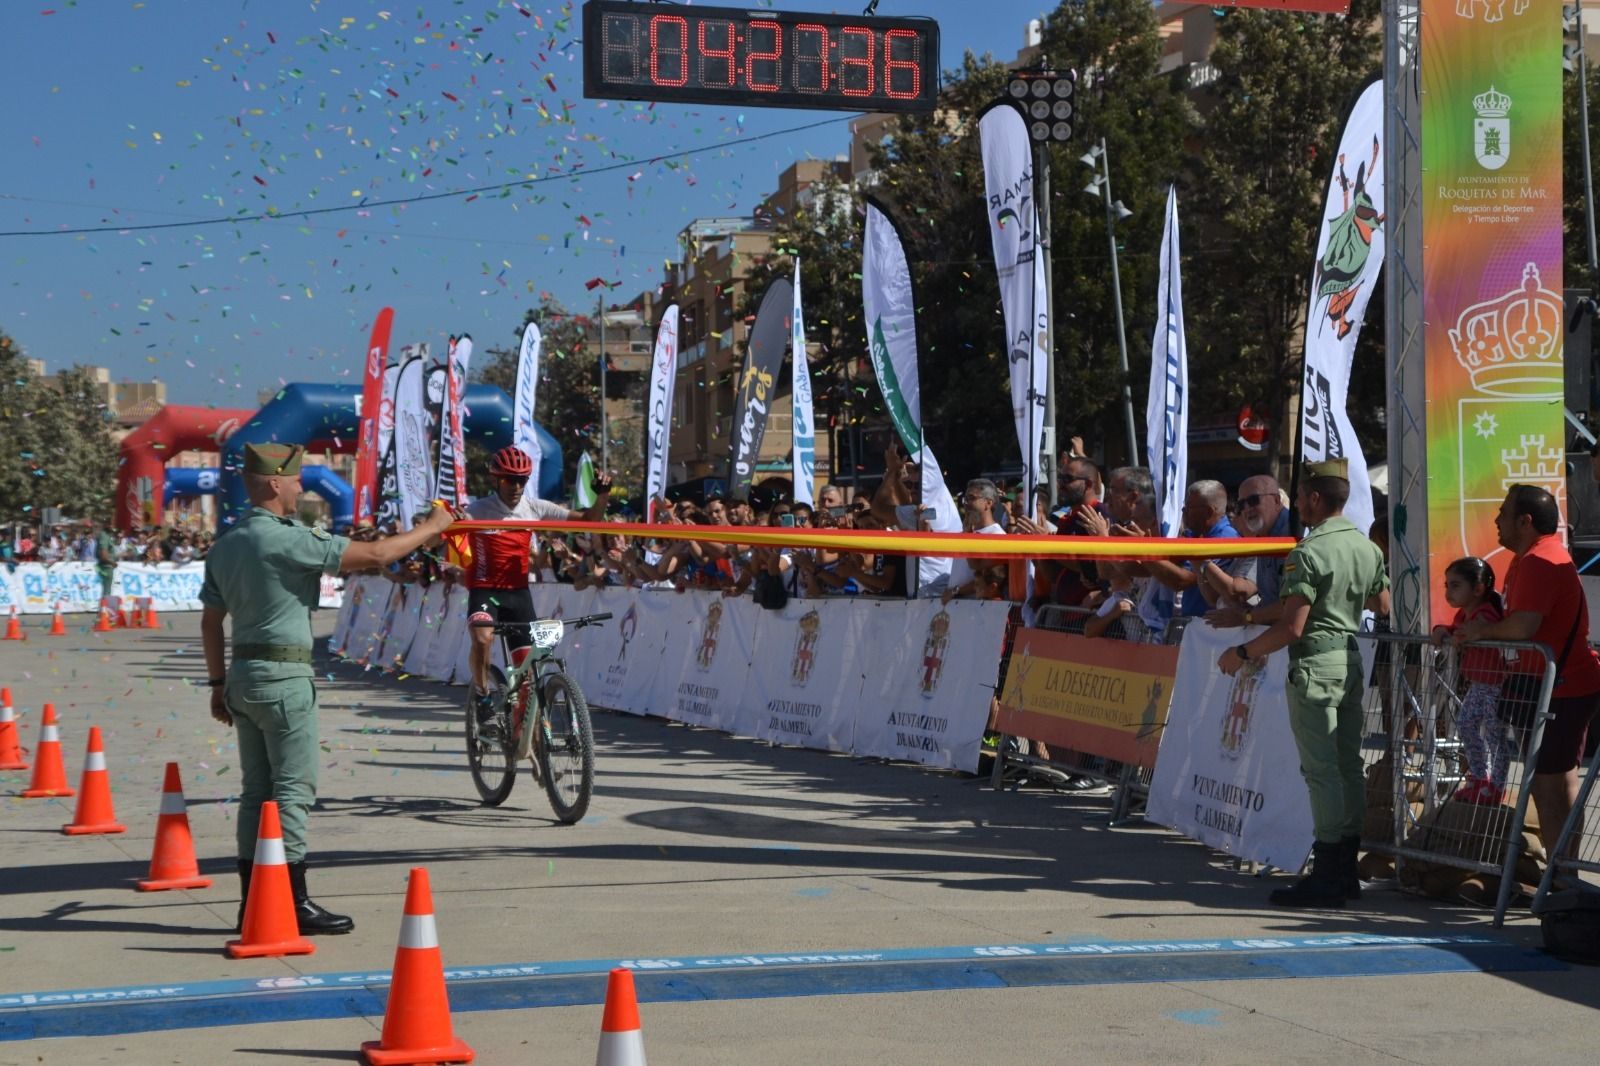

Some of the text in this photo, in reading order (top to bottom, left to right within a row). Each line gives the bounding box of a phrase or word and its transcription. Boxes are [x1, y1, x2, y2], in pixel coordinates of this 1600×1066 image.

[649, 14, 920, 100] 04:27:36
[1457, 176, 1518, 184] AYUNTAMIENTO
[1439, 186, 1547, 200] ROQUETAS DE MAR
[1452, 205, 1534, 215] Delegación de Deportes
[1474, 215, 1500, 224] Tiempo
[1501, 215, 1520, 223] Libre
[1045, 667, 1127, 705] LA DESÉRTICA
[338, 966, 540, 982] camar
